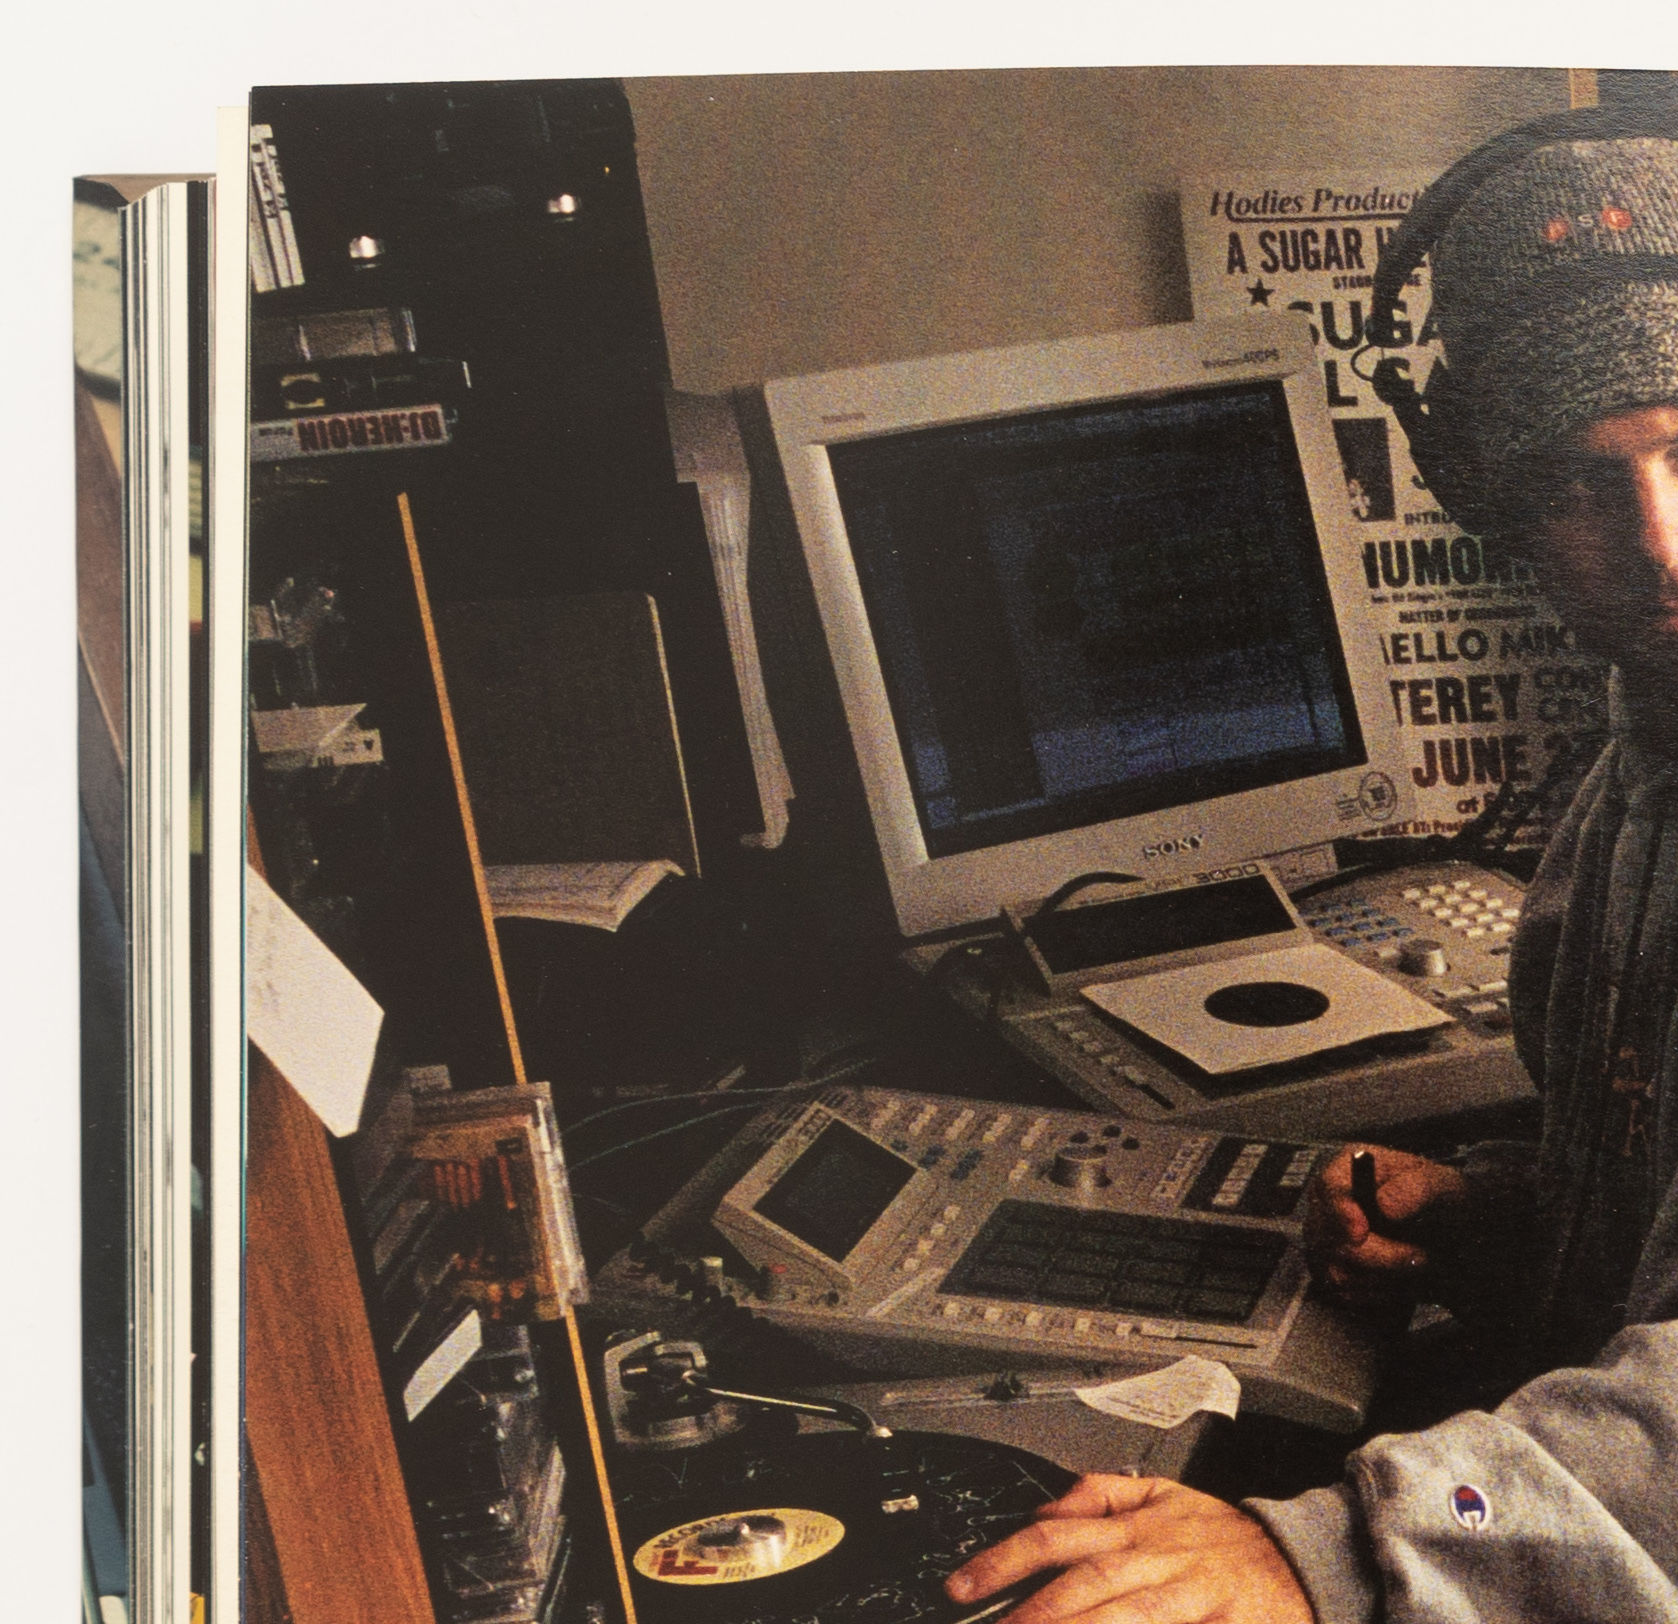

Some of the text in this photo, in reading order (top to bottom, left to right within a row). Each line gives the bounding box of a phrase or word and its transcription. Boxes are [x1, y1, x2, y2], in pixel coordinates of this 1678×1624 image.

[1210, 189, 1304, 217] Hodies
[1227, 231, 1248, 275] A
[1258, 227, 1366, 274] SUGAR
[1379, 627, 1490, 666] ELLO
[1412, 734, 1531, 789] JUNE
[1143, 833, 1204, 859] SONY
